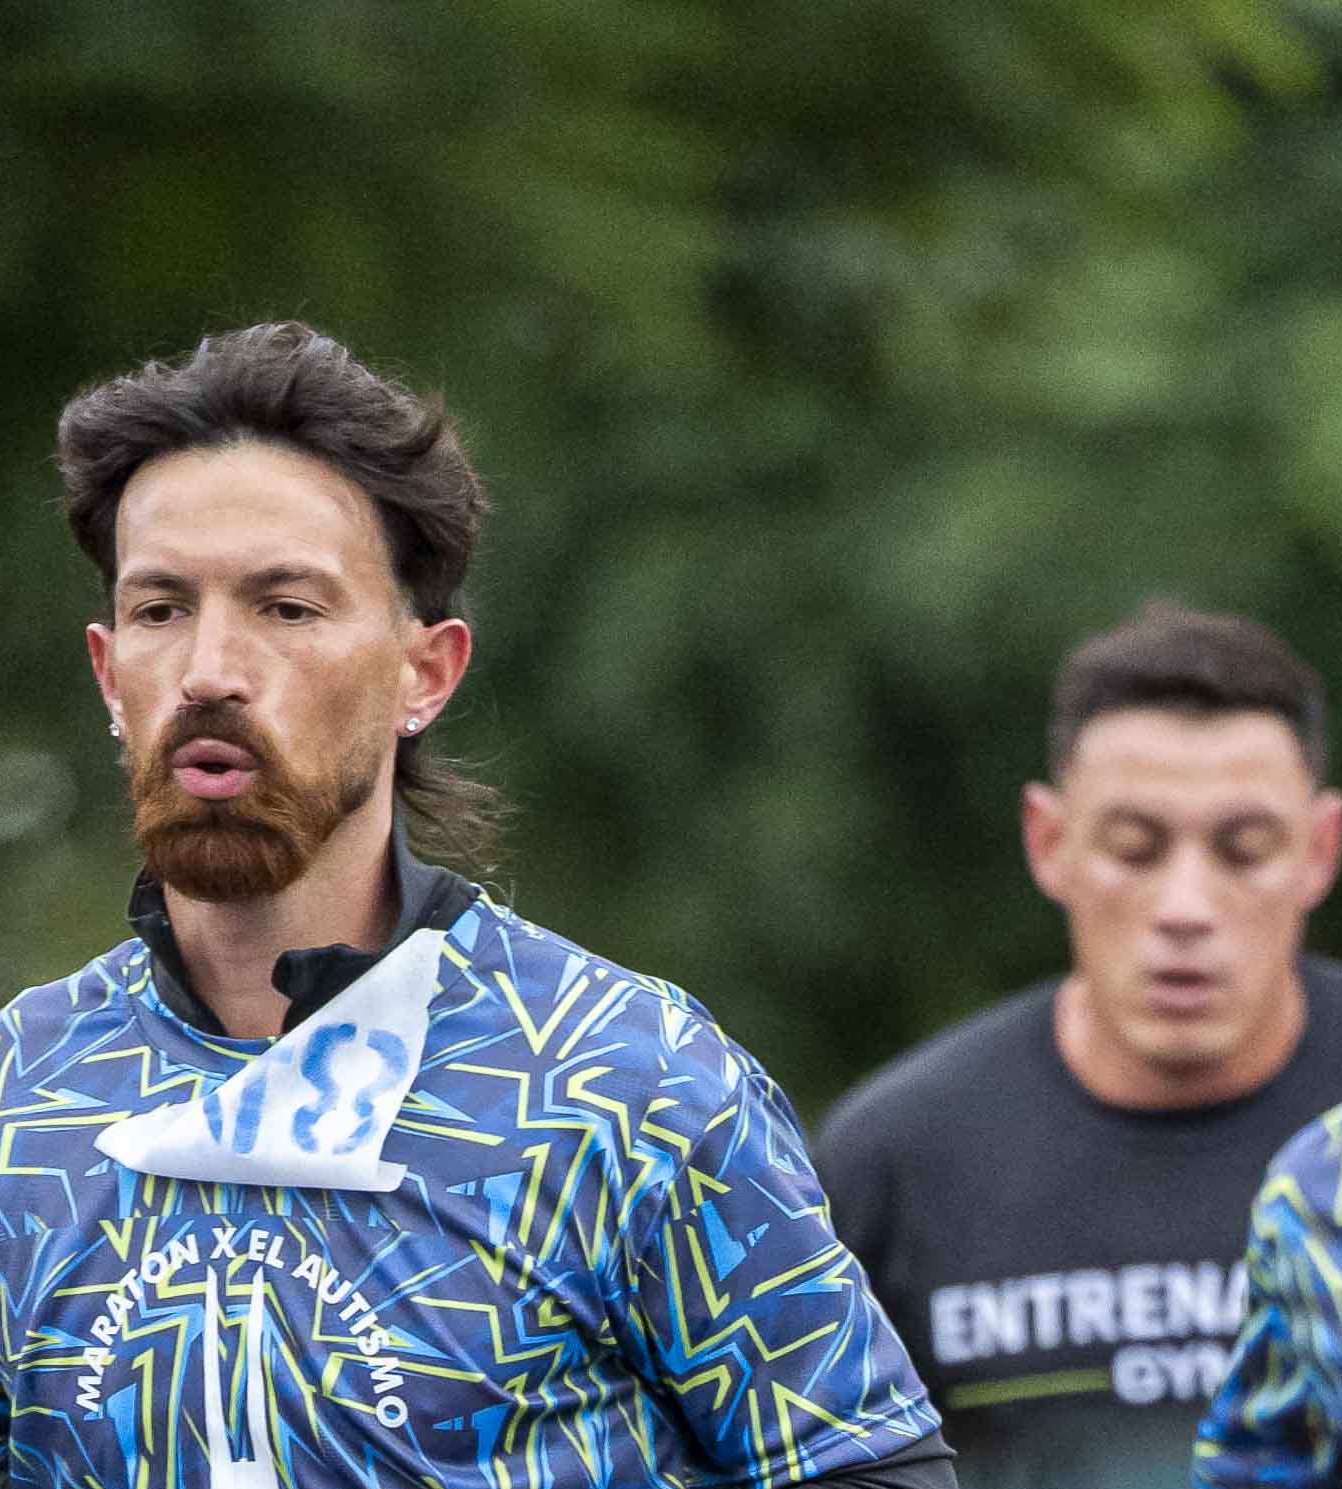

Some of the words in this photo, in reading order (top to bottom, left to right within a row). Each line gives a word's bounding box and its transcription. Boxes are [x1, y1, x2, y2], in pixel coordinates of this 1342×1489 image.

[210, 1227, 239, 1258] X
[247, 1229, 285, 1268] EL
[291, 1253, 408, 1428] AUTISMO
